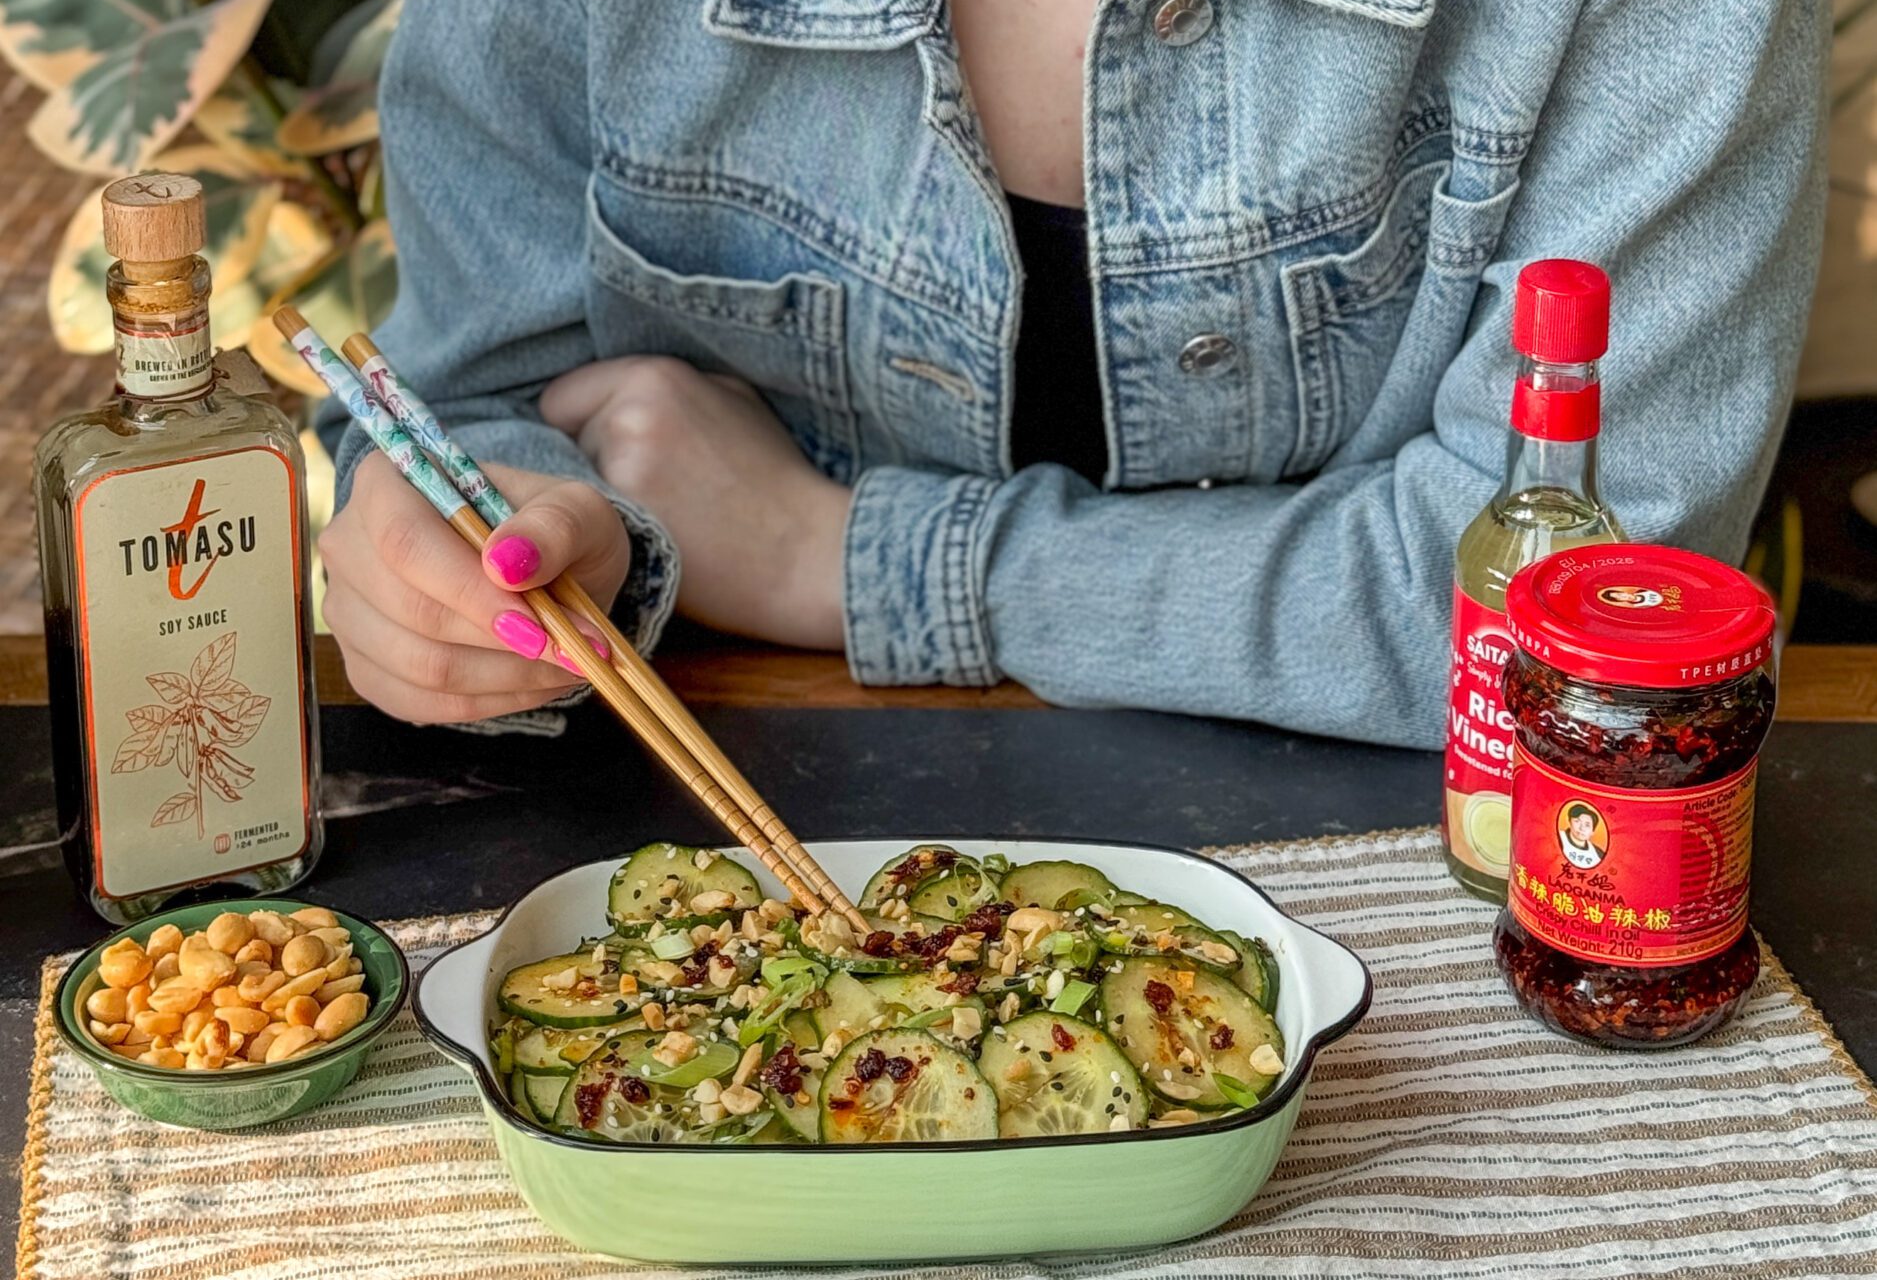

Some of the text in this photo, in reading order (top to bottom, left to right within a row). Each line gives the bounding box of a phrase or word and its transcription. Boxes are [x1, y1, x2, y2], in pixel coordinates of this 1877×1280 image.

[135, 360, 172, 373] BREWED
[177, 358, 188, 370] IN
[119, 516, 256, 576] TOMASU
[1558, 557, 1576, 569] EU
[159, 609, 228, 636] SOY SAUCE
[1684, 798, 1716, 812] Article
[234, 821, 279, 840] FERMENTED
[257, 832, 290, 844] months
[1548, 875, 1626, 906] LAOGANMA
[1535, 902, 1568, 927] Crispy
[1621, 928, 1640, 941] Oil
[1538, 919, 1643, 959] Net Weight: 210g
